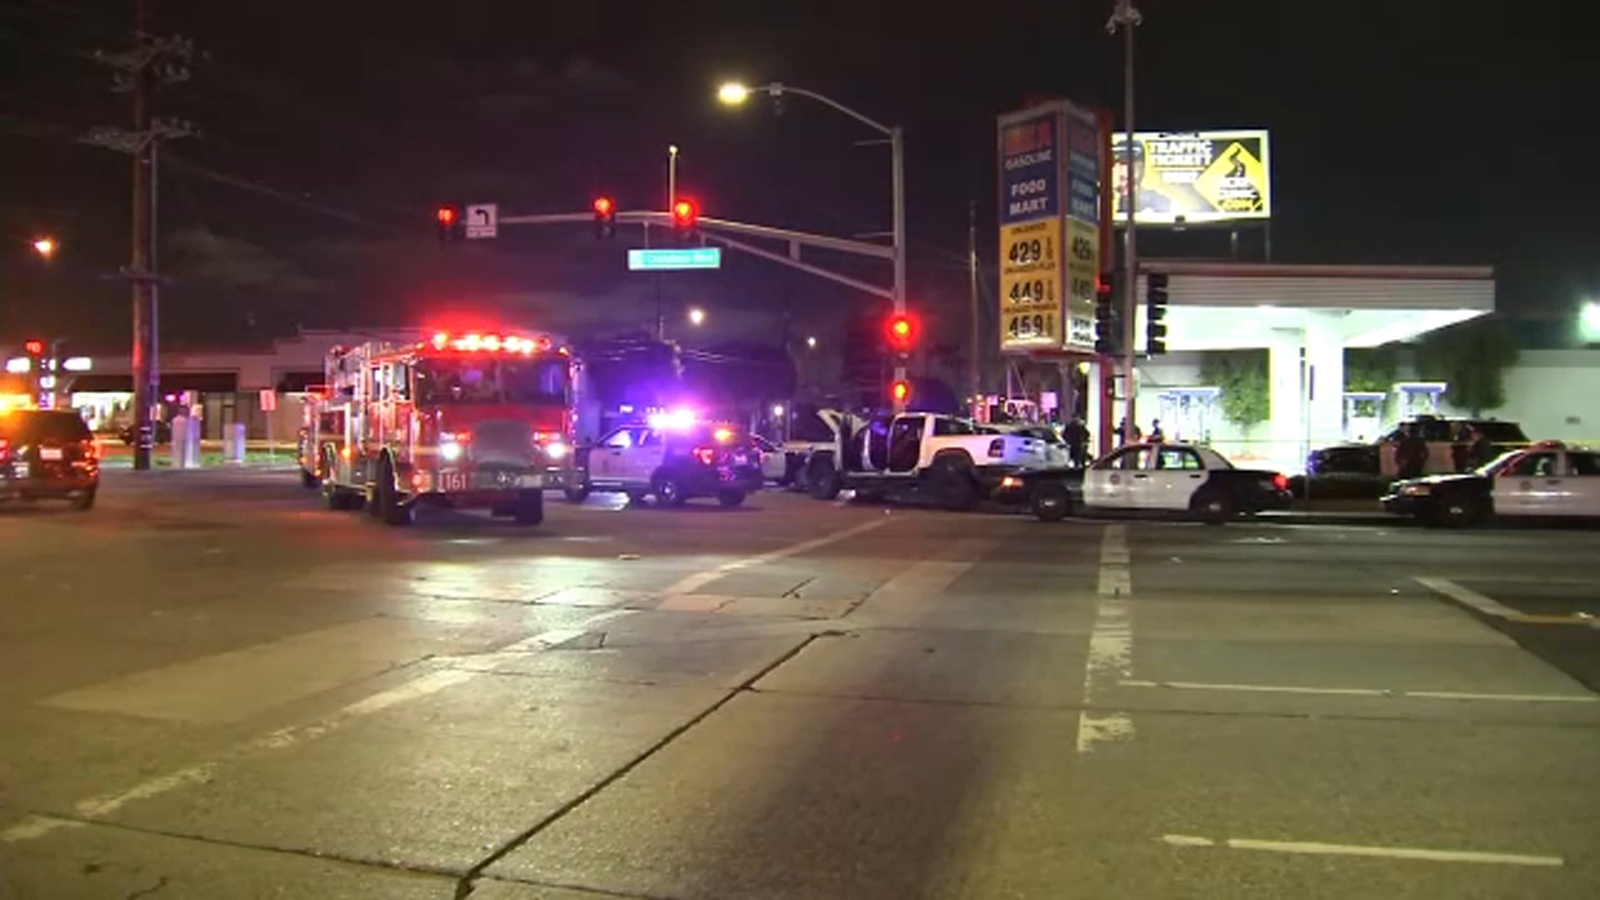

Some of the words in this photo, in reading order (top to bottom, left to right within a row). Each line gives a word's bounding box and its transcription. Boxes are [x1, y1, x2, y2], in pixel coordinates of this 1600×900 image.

[1148, 141, 1212, 155] TRAFFIC
[1005, 149, 1053, 171] GASOLINE
[1011, 179, 1047, 197] FOOD
[1009, 197, 1049, 215] MART
[1009, 239, 1042, 263] 429
[1009, 280, 1044, 303] 449
[1009, 314, 1044, 338] 459
